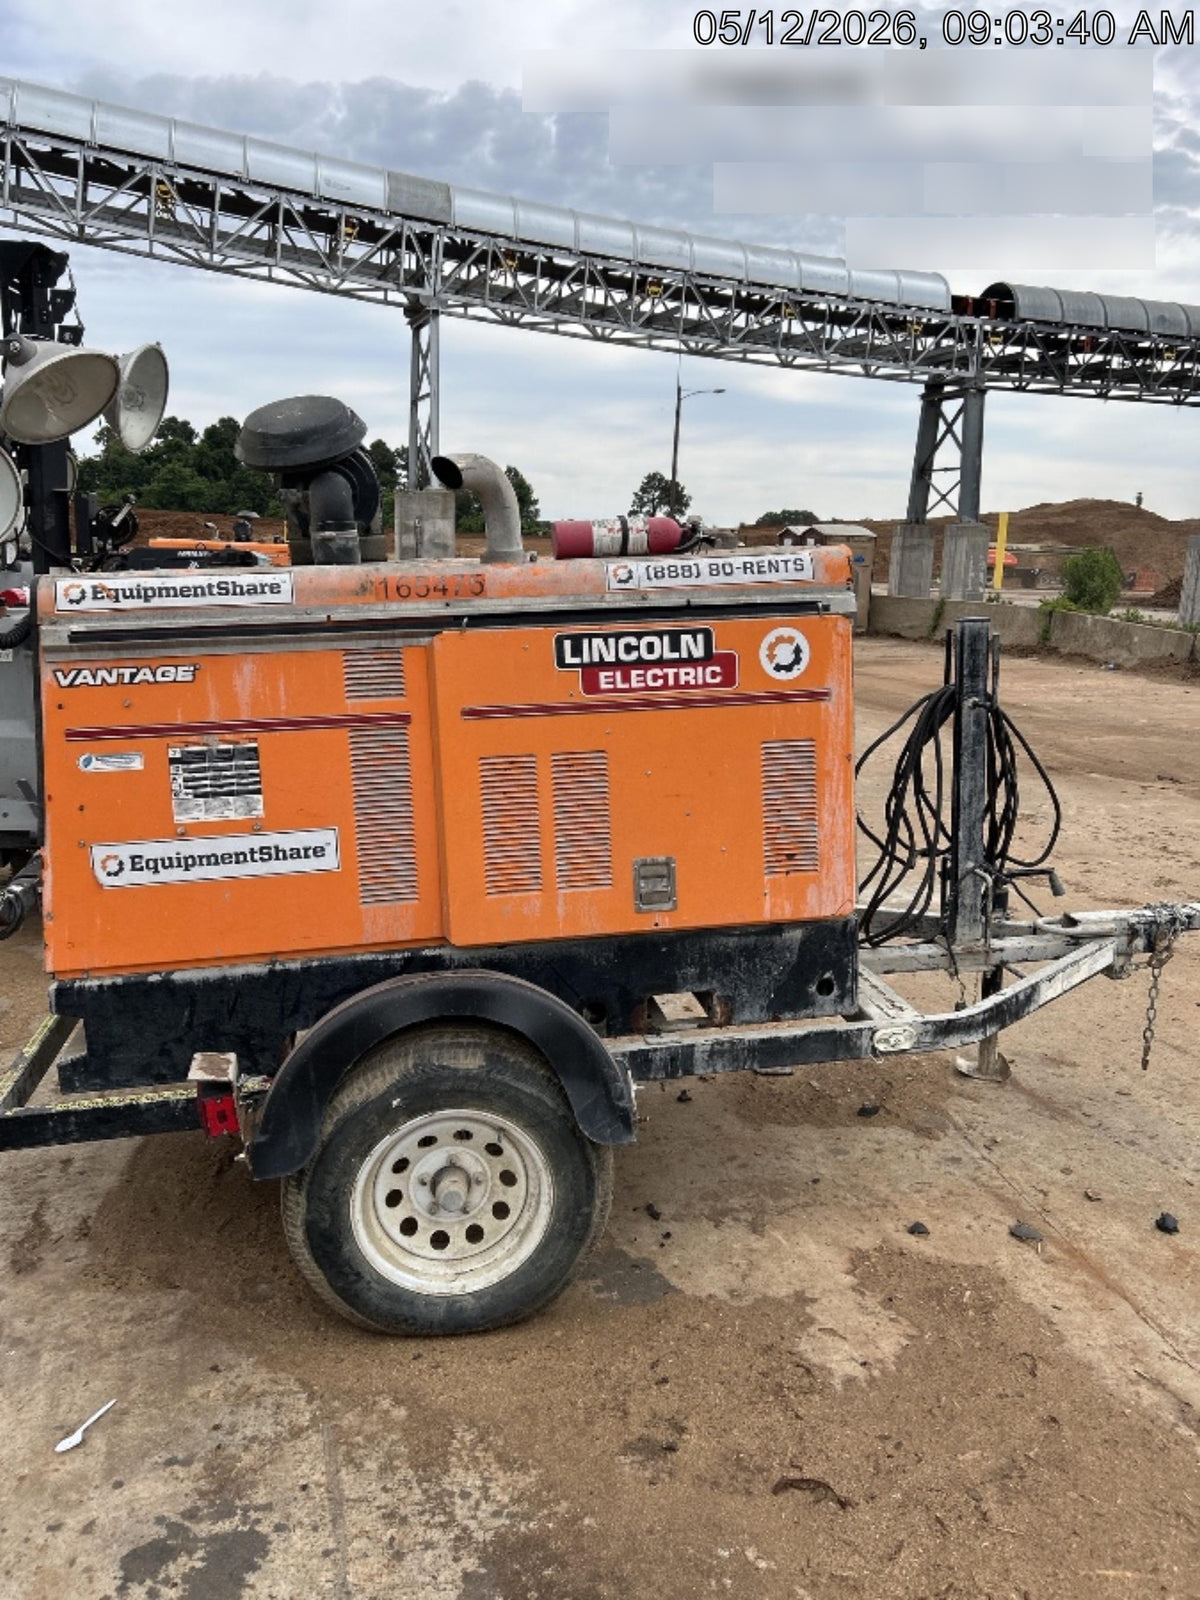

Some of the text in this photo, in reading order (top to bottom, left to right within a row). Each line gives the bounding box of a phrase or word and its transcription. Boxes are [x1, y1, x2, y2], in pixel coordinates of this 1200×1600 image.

[646, 558, 805, 581] (888) 80-RENTS
[563, 633, 705, 664] LINCOLN
[53, 664, 196, 687] VANTAGE
[599, 666, 723, 690] ELECTRIC
